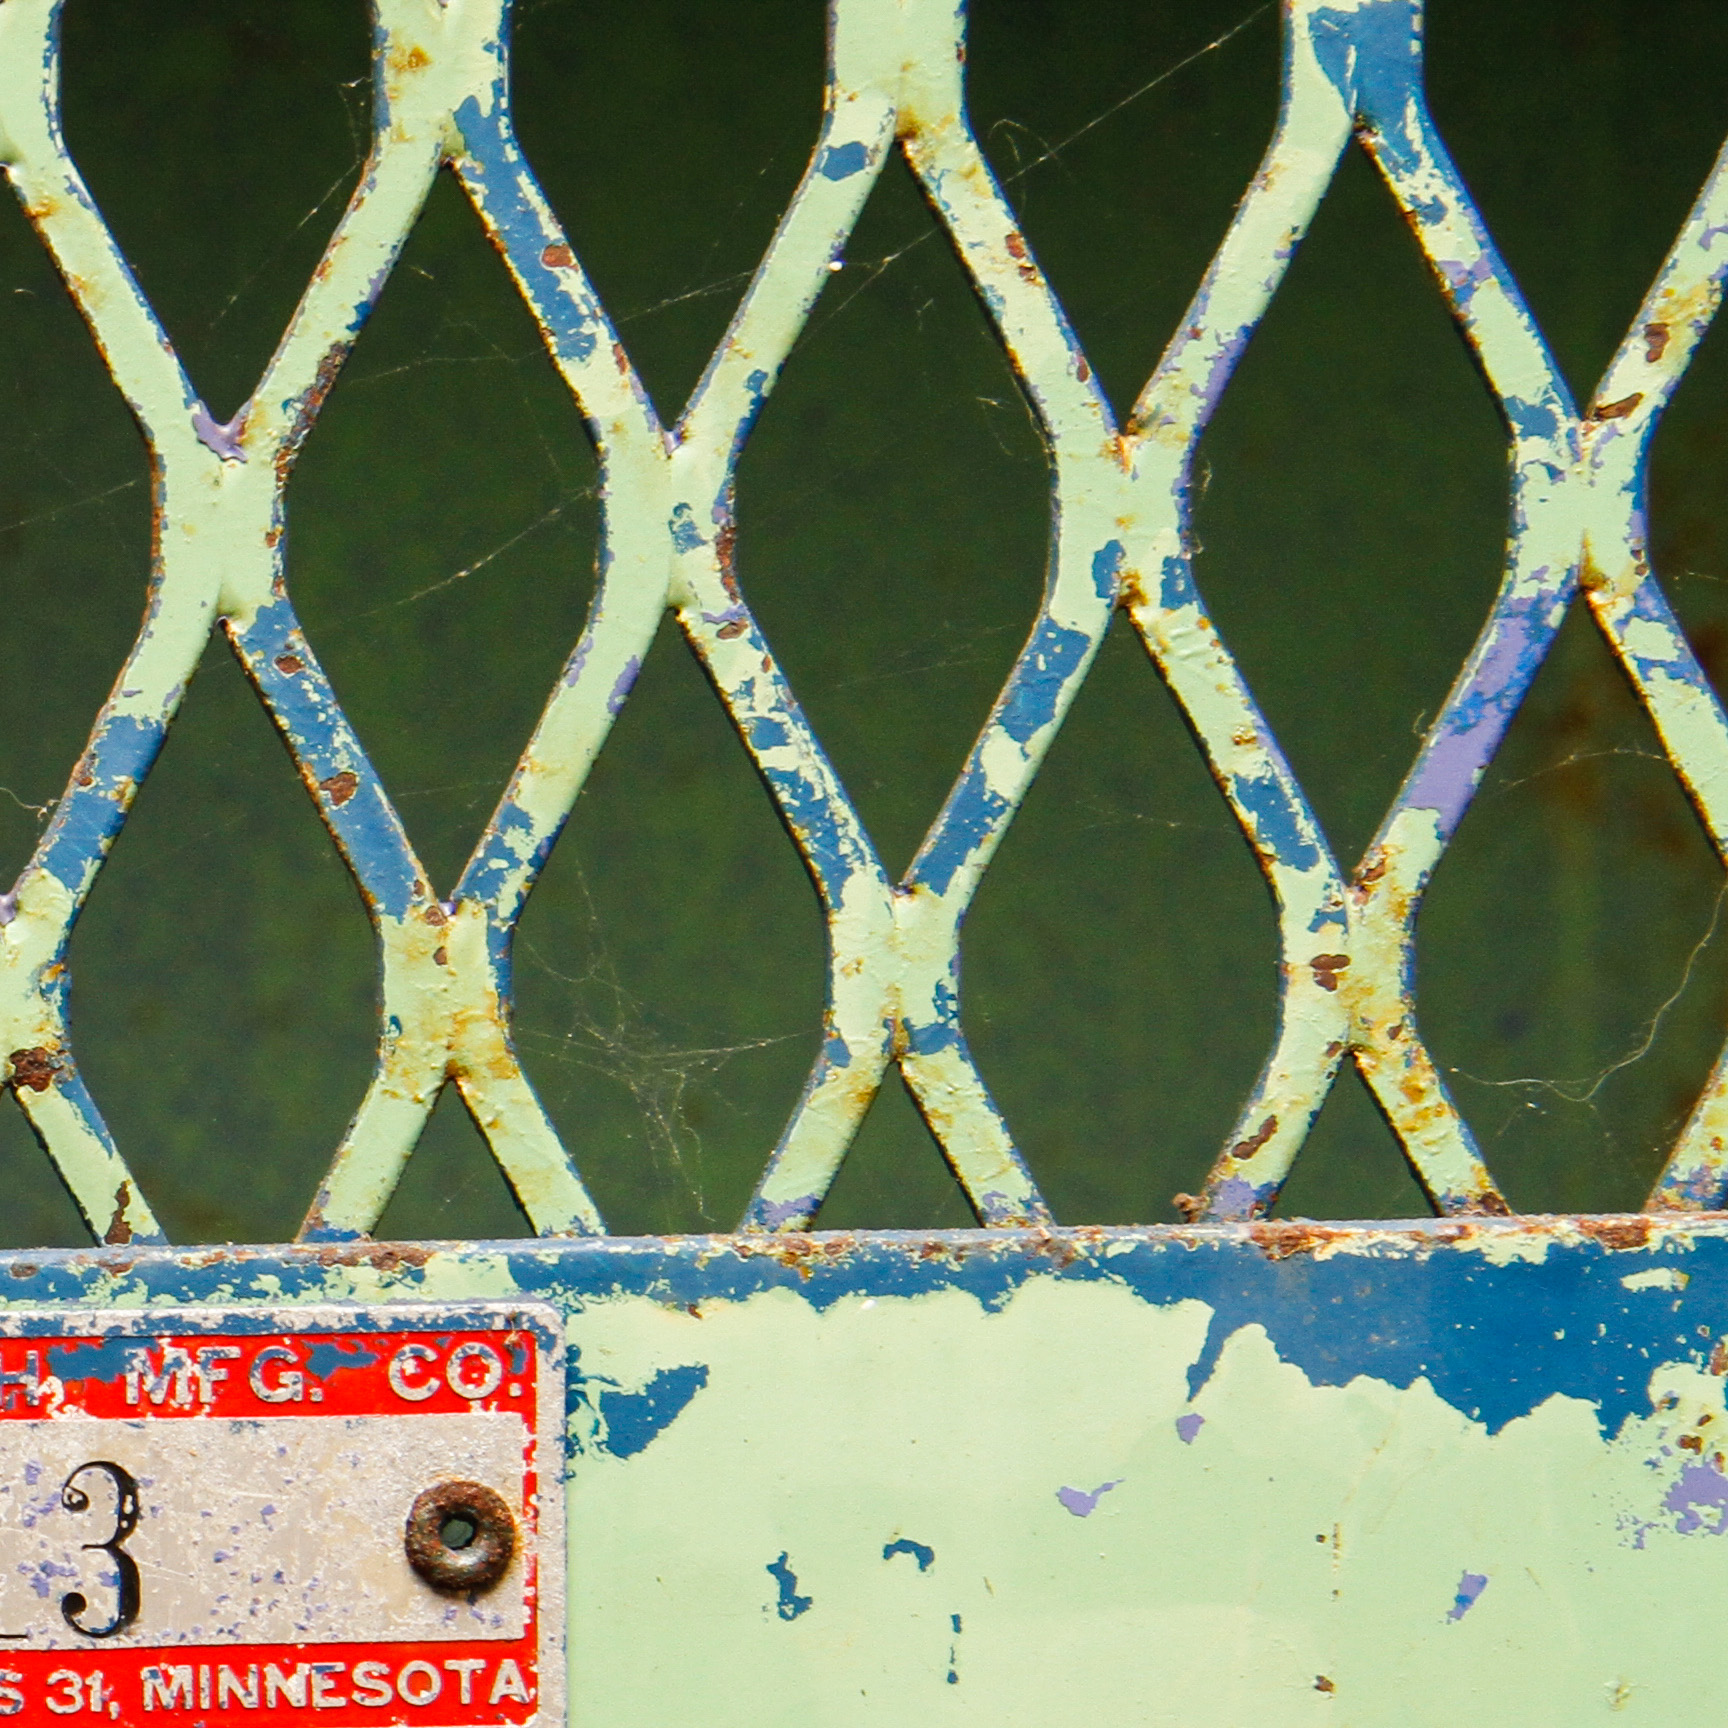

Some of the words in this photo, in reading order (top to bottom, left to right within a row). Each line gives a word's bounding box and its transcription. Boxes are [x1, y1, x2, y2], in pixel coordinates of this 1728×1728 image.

[124, 1344, 323, 1405] MFG.
[388, 1341, 523, 1401] CO.
[45, 1667, 118, 1721] 31,
[140, 1658, 532, 1712] MINNESOTA
